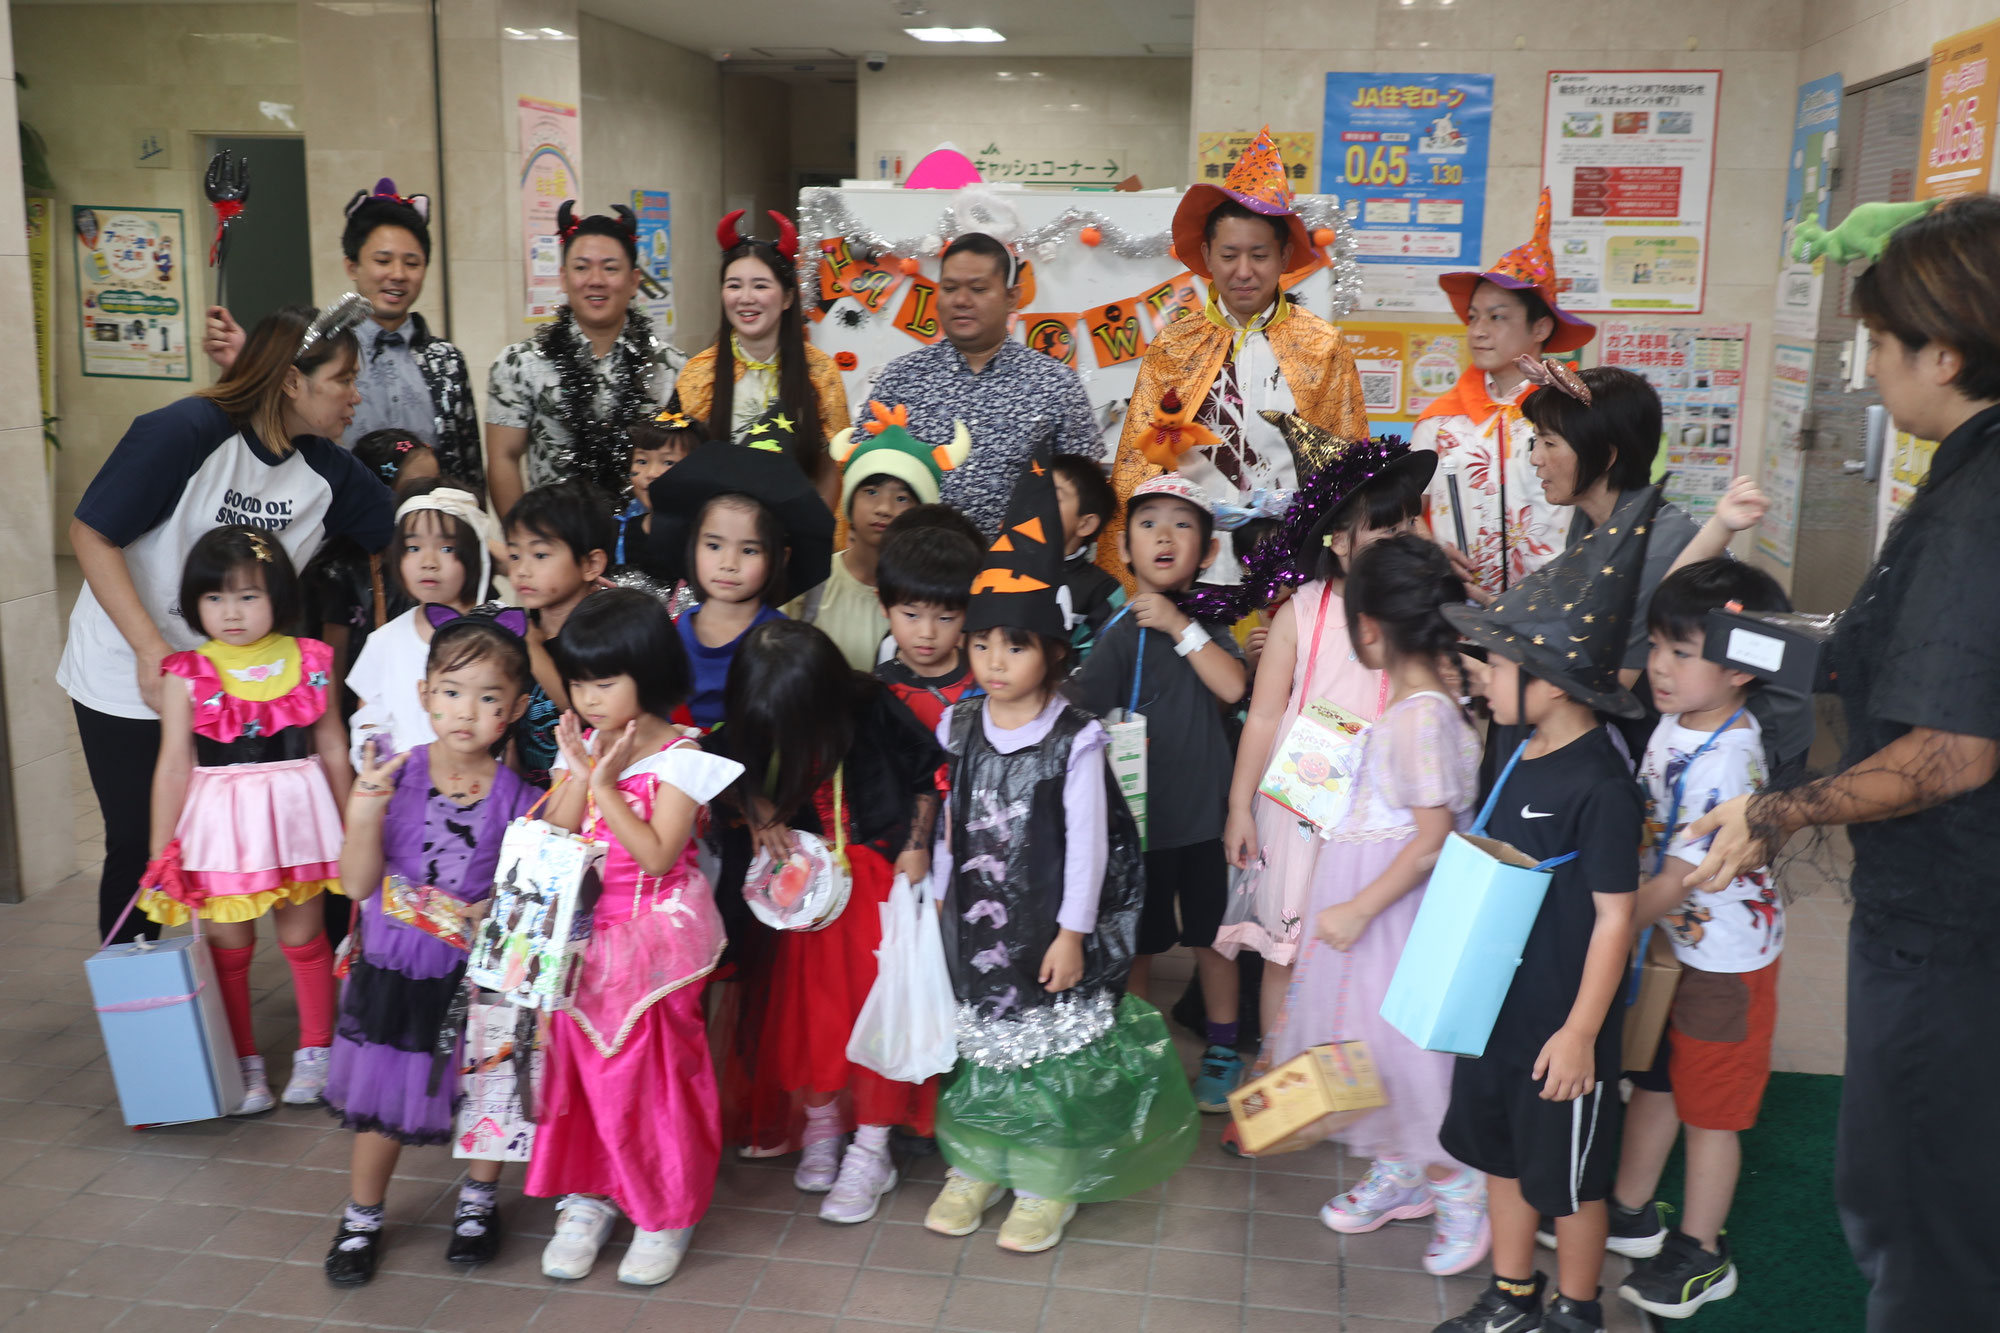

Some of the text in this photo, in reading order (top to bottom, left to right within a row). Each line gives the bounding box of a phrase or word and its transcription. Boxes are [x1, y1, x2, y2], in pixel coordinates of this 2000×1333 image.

[1352, 85, 1466, 109] JA住宅ローン
[1345, 144, 1408, 186] 0.65
[224, 489, 293, 515] GOOD OL'
